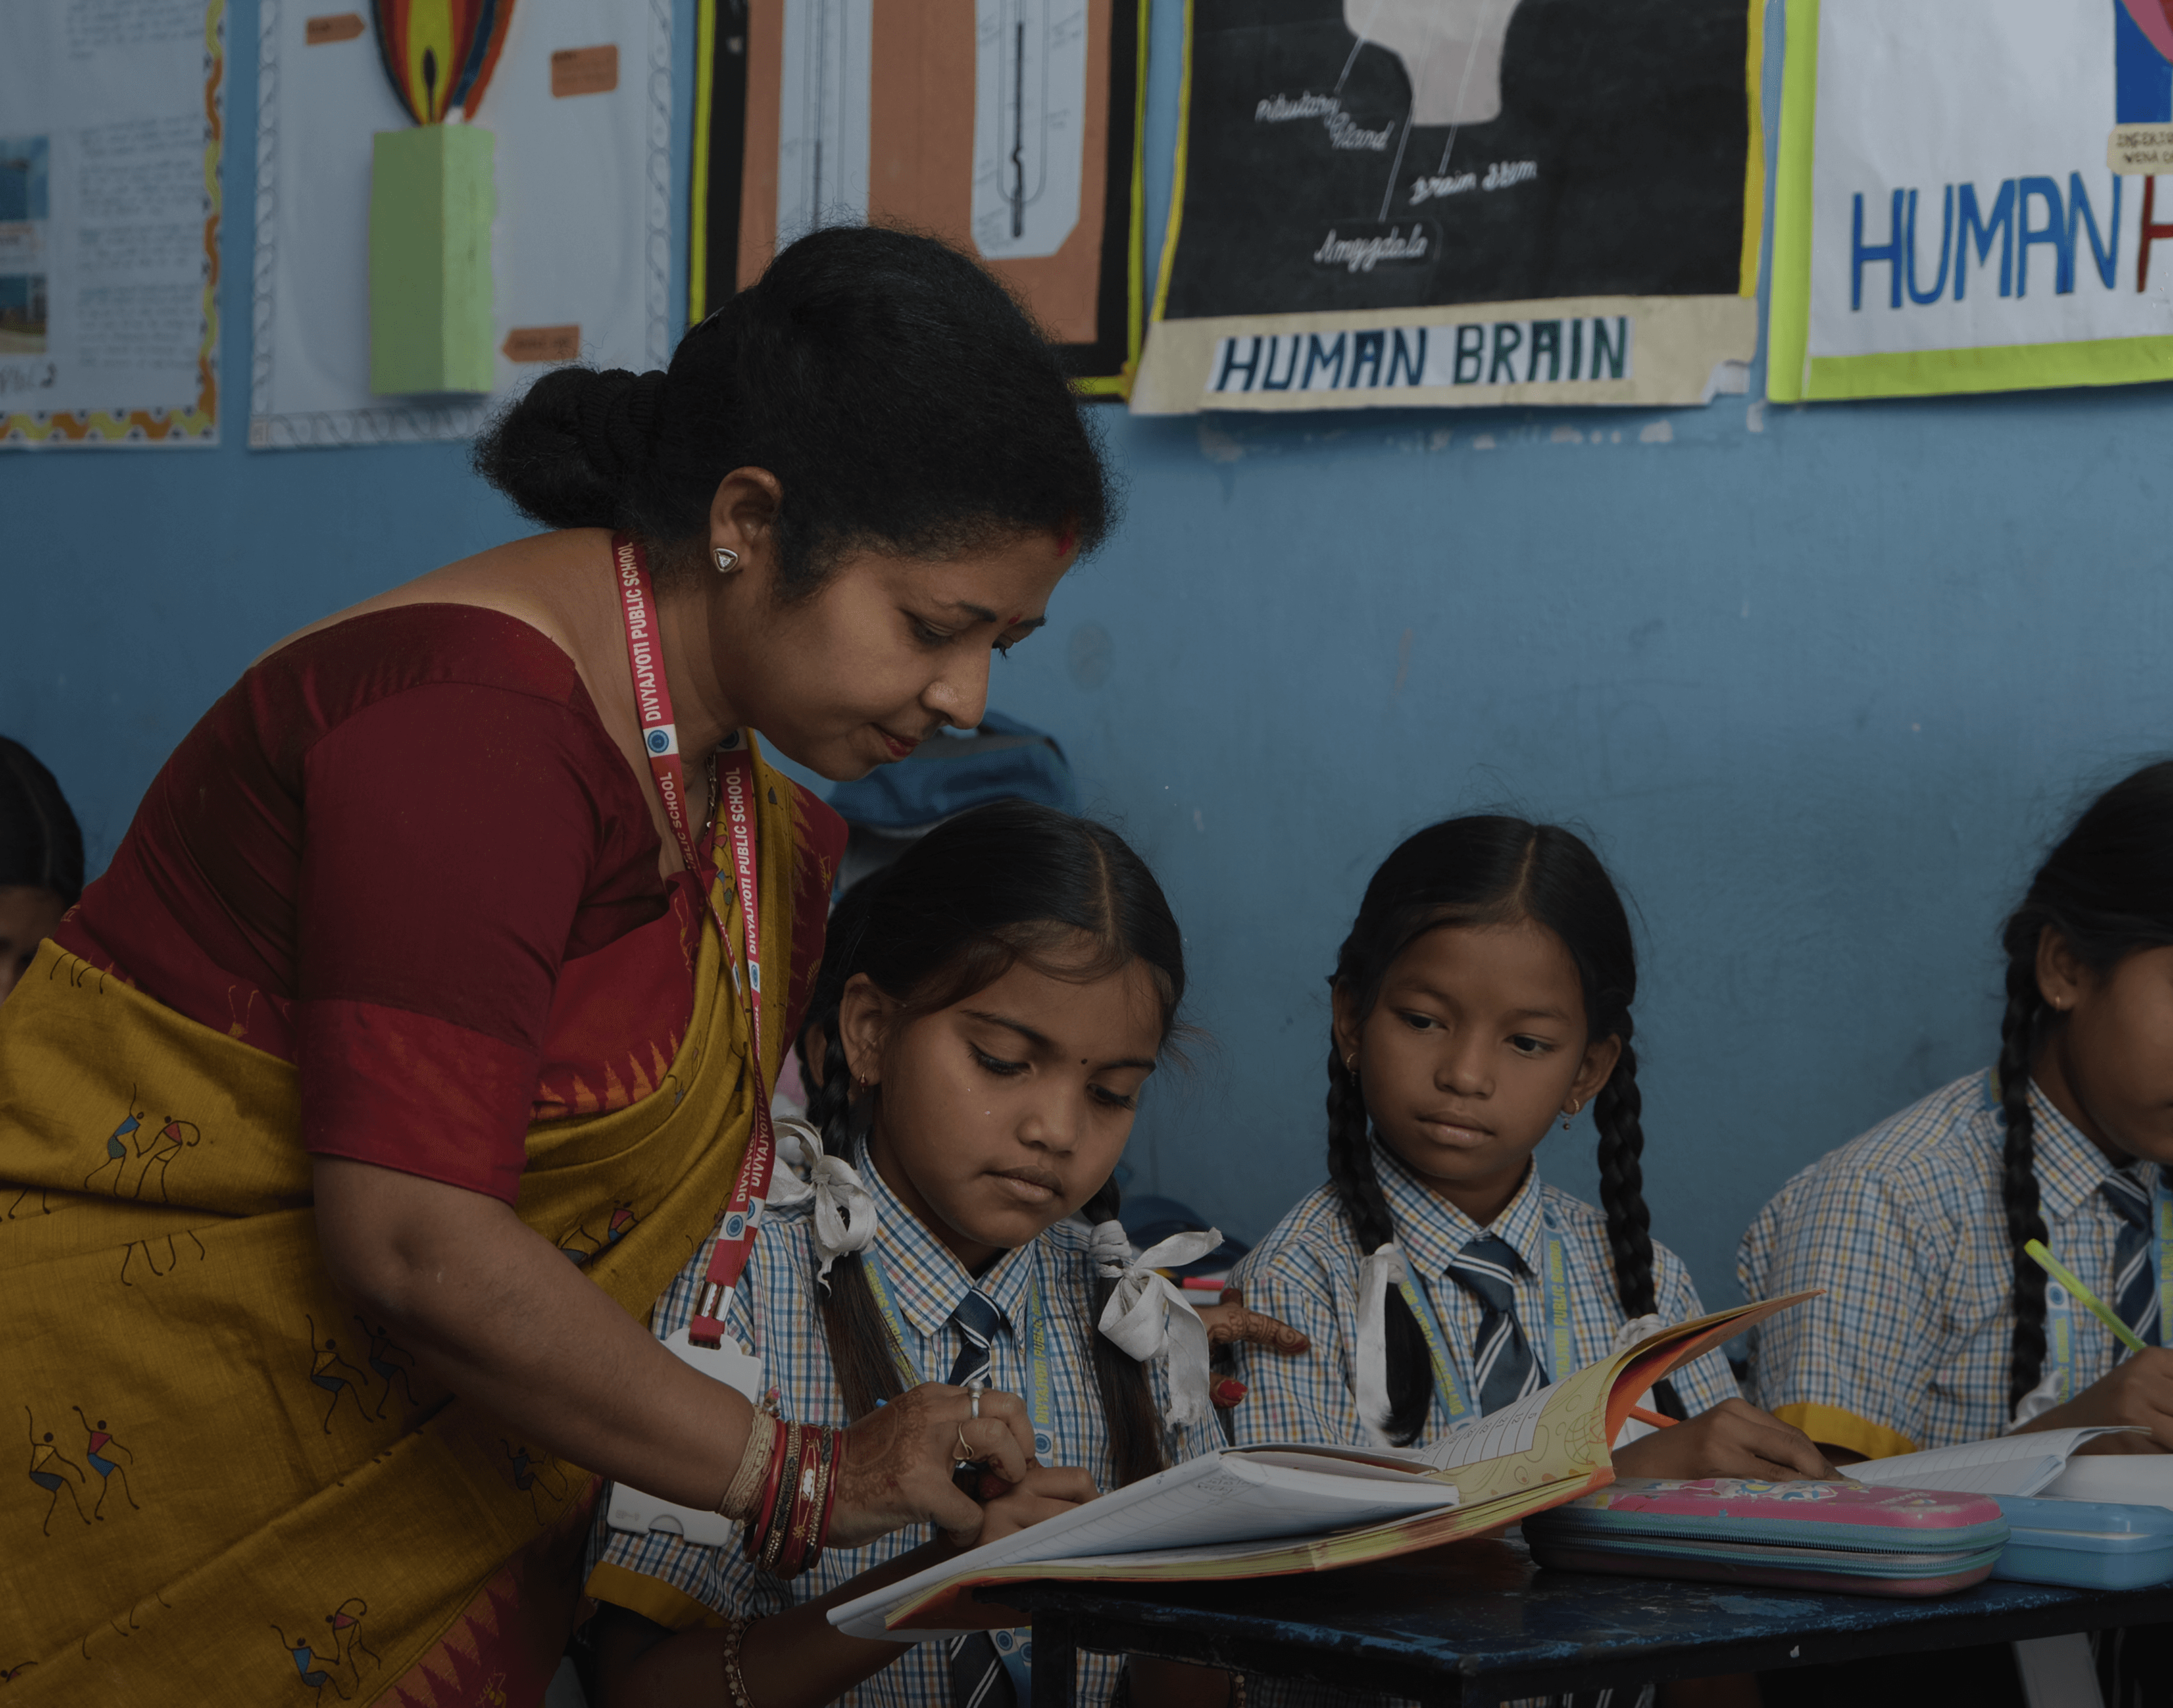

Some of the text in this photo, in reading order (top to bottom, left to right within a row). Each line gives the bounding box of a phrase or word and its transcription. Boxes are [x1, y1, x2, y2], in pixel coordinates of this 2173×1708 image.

[1851, 171, 2122, 311] HUMAN
[1216, 316, 1628, 393] HUMAN BRAIN
[618, 541, 661, 722] DIVYAJYOTI PUBLIC SCHOOL
[659, 772, 697, 870] UBLIC SCHOOL
[726, 768, 757, 954] DIVYAJYOTI PUBLIC SCHOOL
[749, 1109, 769, 1188] DIVYAJYOTI
[1032, 1318, 1046, 1359] PUBLIC
[1552, 1285, 1568, 1327] PUBLIC
[1034, 1359, 1050, 1424] DIVYAJYOTI
[1554, 1328, 1572, 1383] VYAJYOTI
